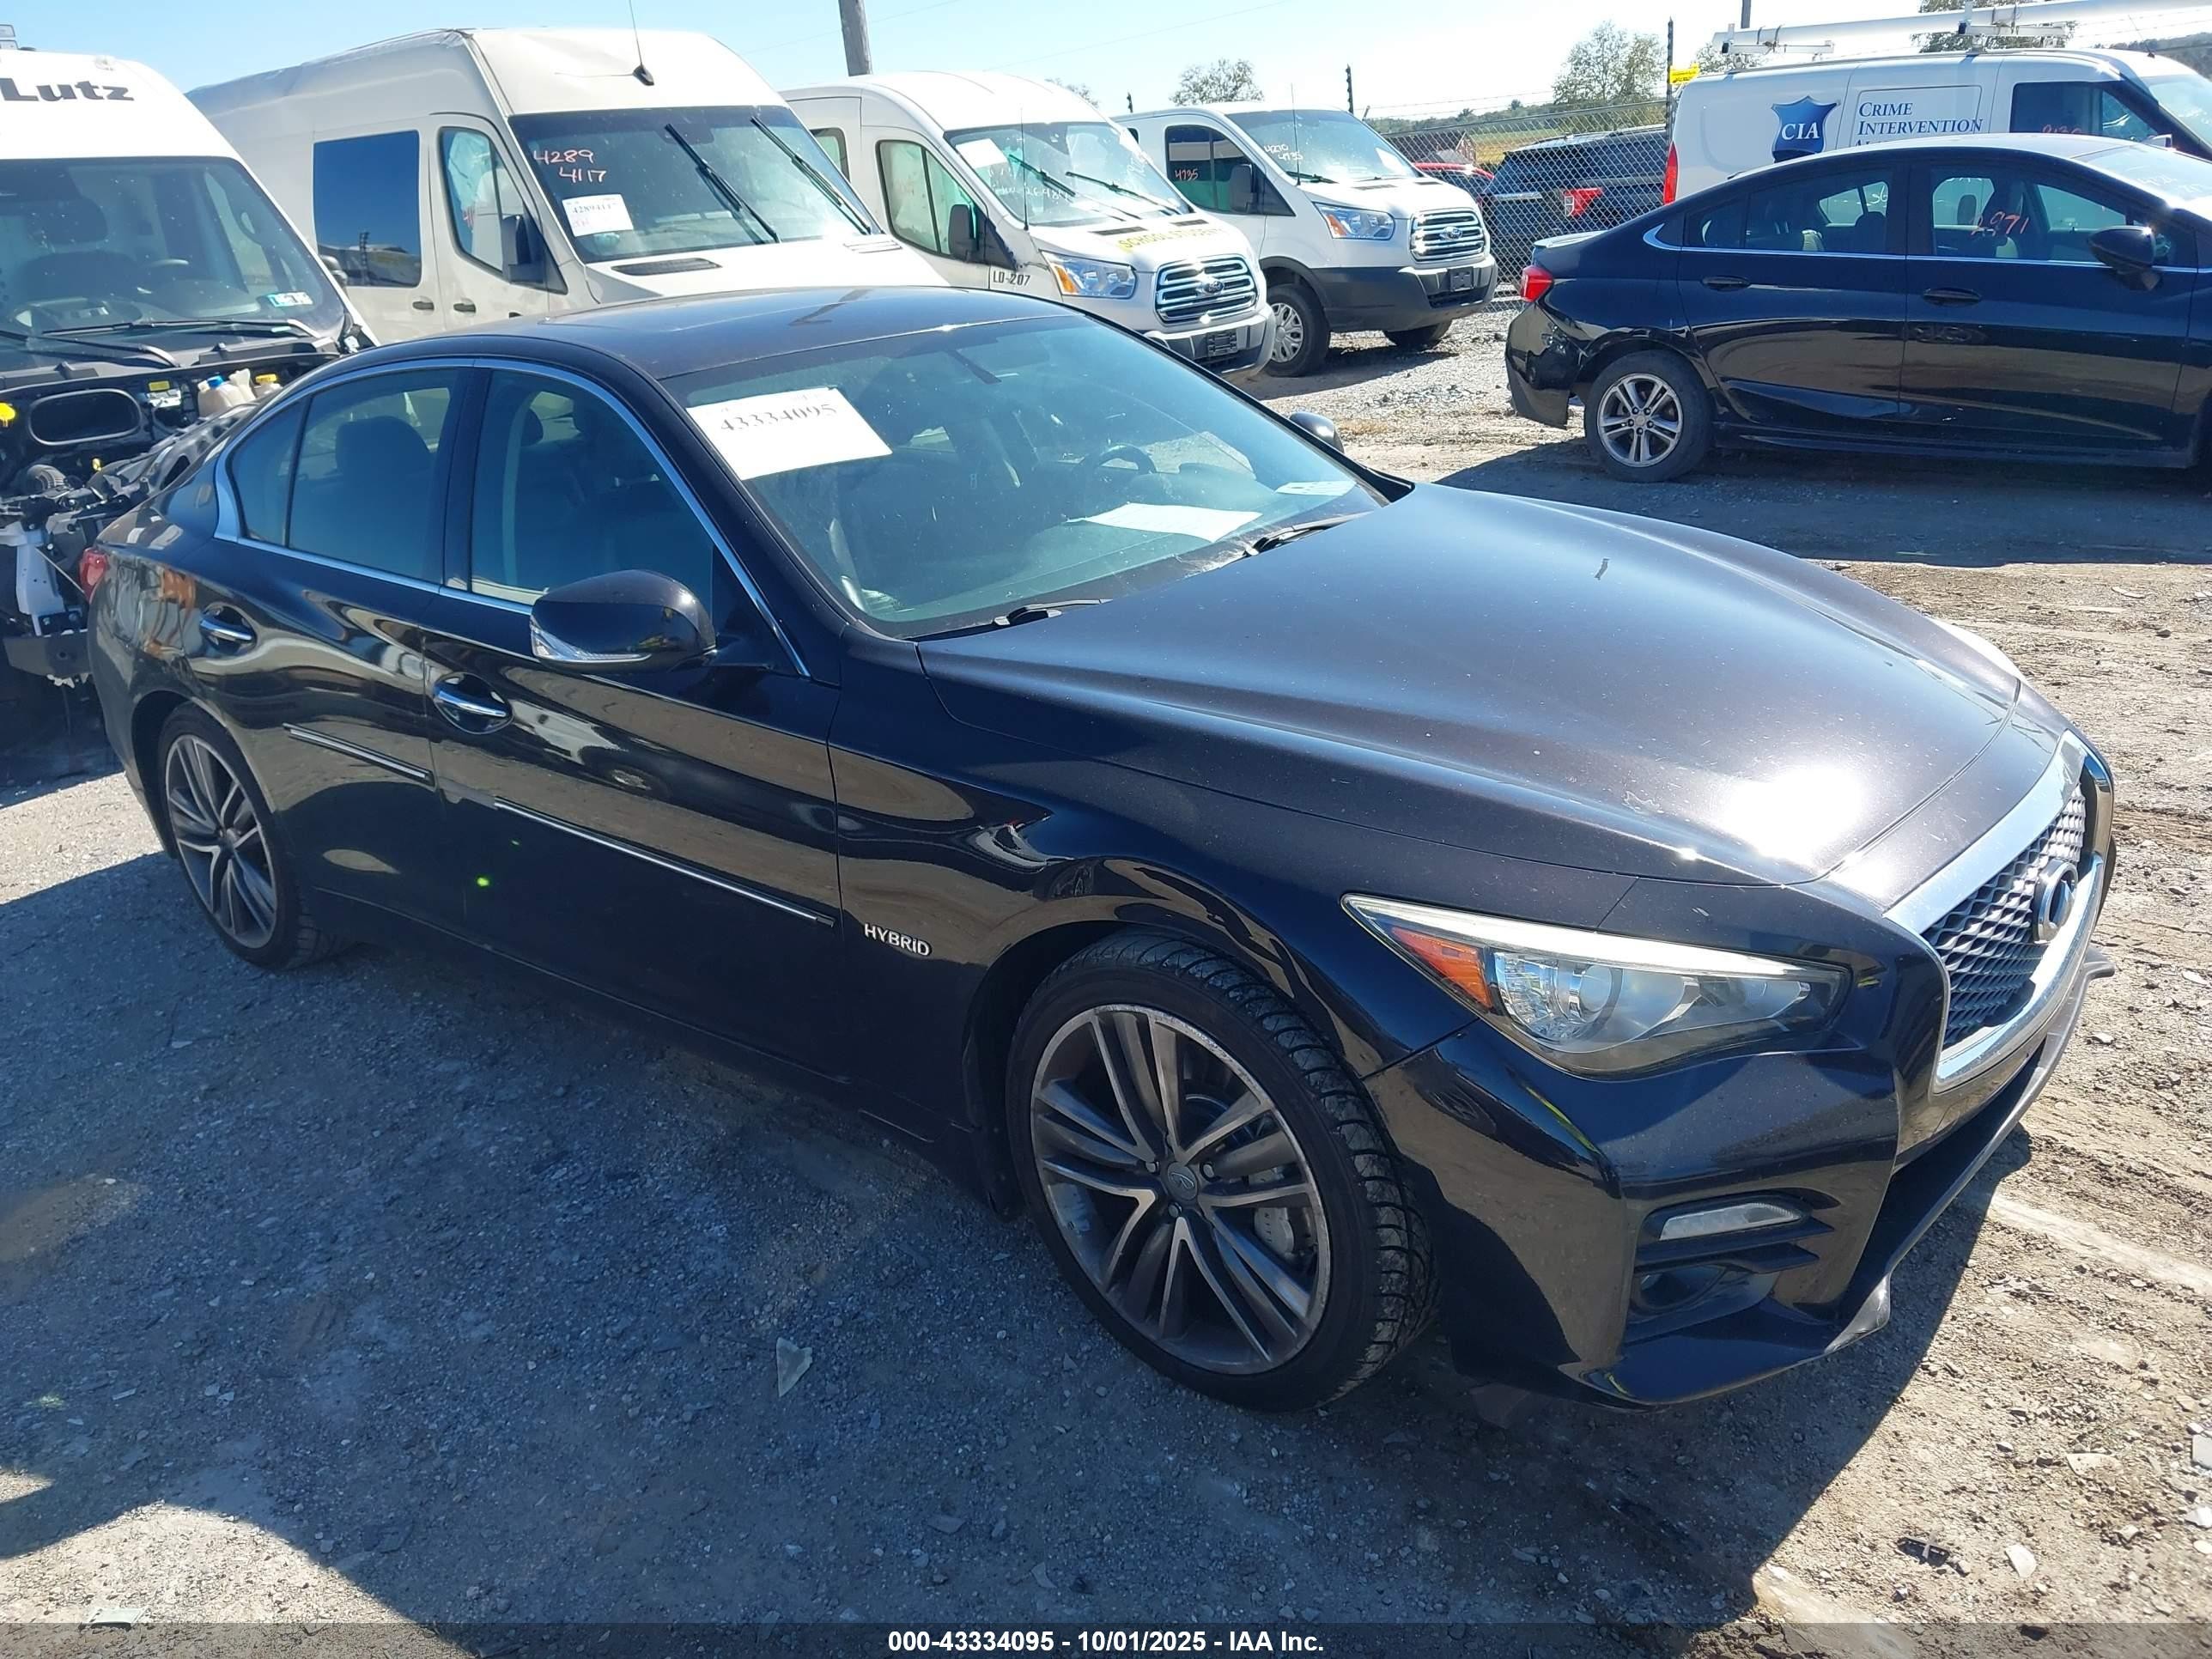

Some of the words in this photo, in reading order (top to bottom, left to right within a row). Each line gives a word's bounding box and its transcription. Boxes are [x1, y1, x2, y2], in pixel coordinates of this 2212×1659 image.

[0, 77, 135, 102] Lutz
[1858, 101, 1914, 118] CRIME
[1781, 121, 1821, 141] CIA
[1857, 118, 1984, 136] INTERVENTION
[533, 149, 594, 165] 4289
[559, 167, 607, 183] 4117
[993, 270, 1030, 286] LD-207
[720, 403, 837, 431] 43334095
[864, 923, 930, 957] HYBRID
